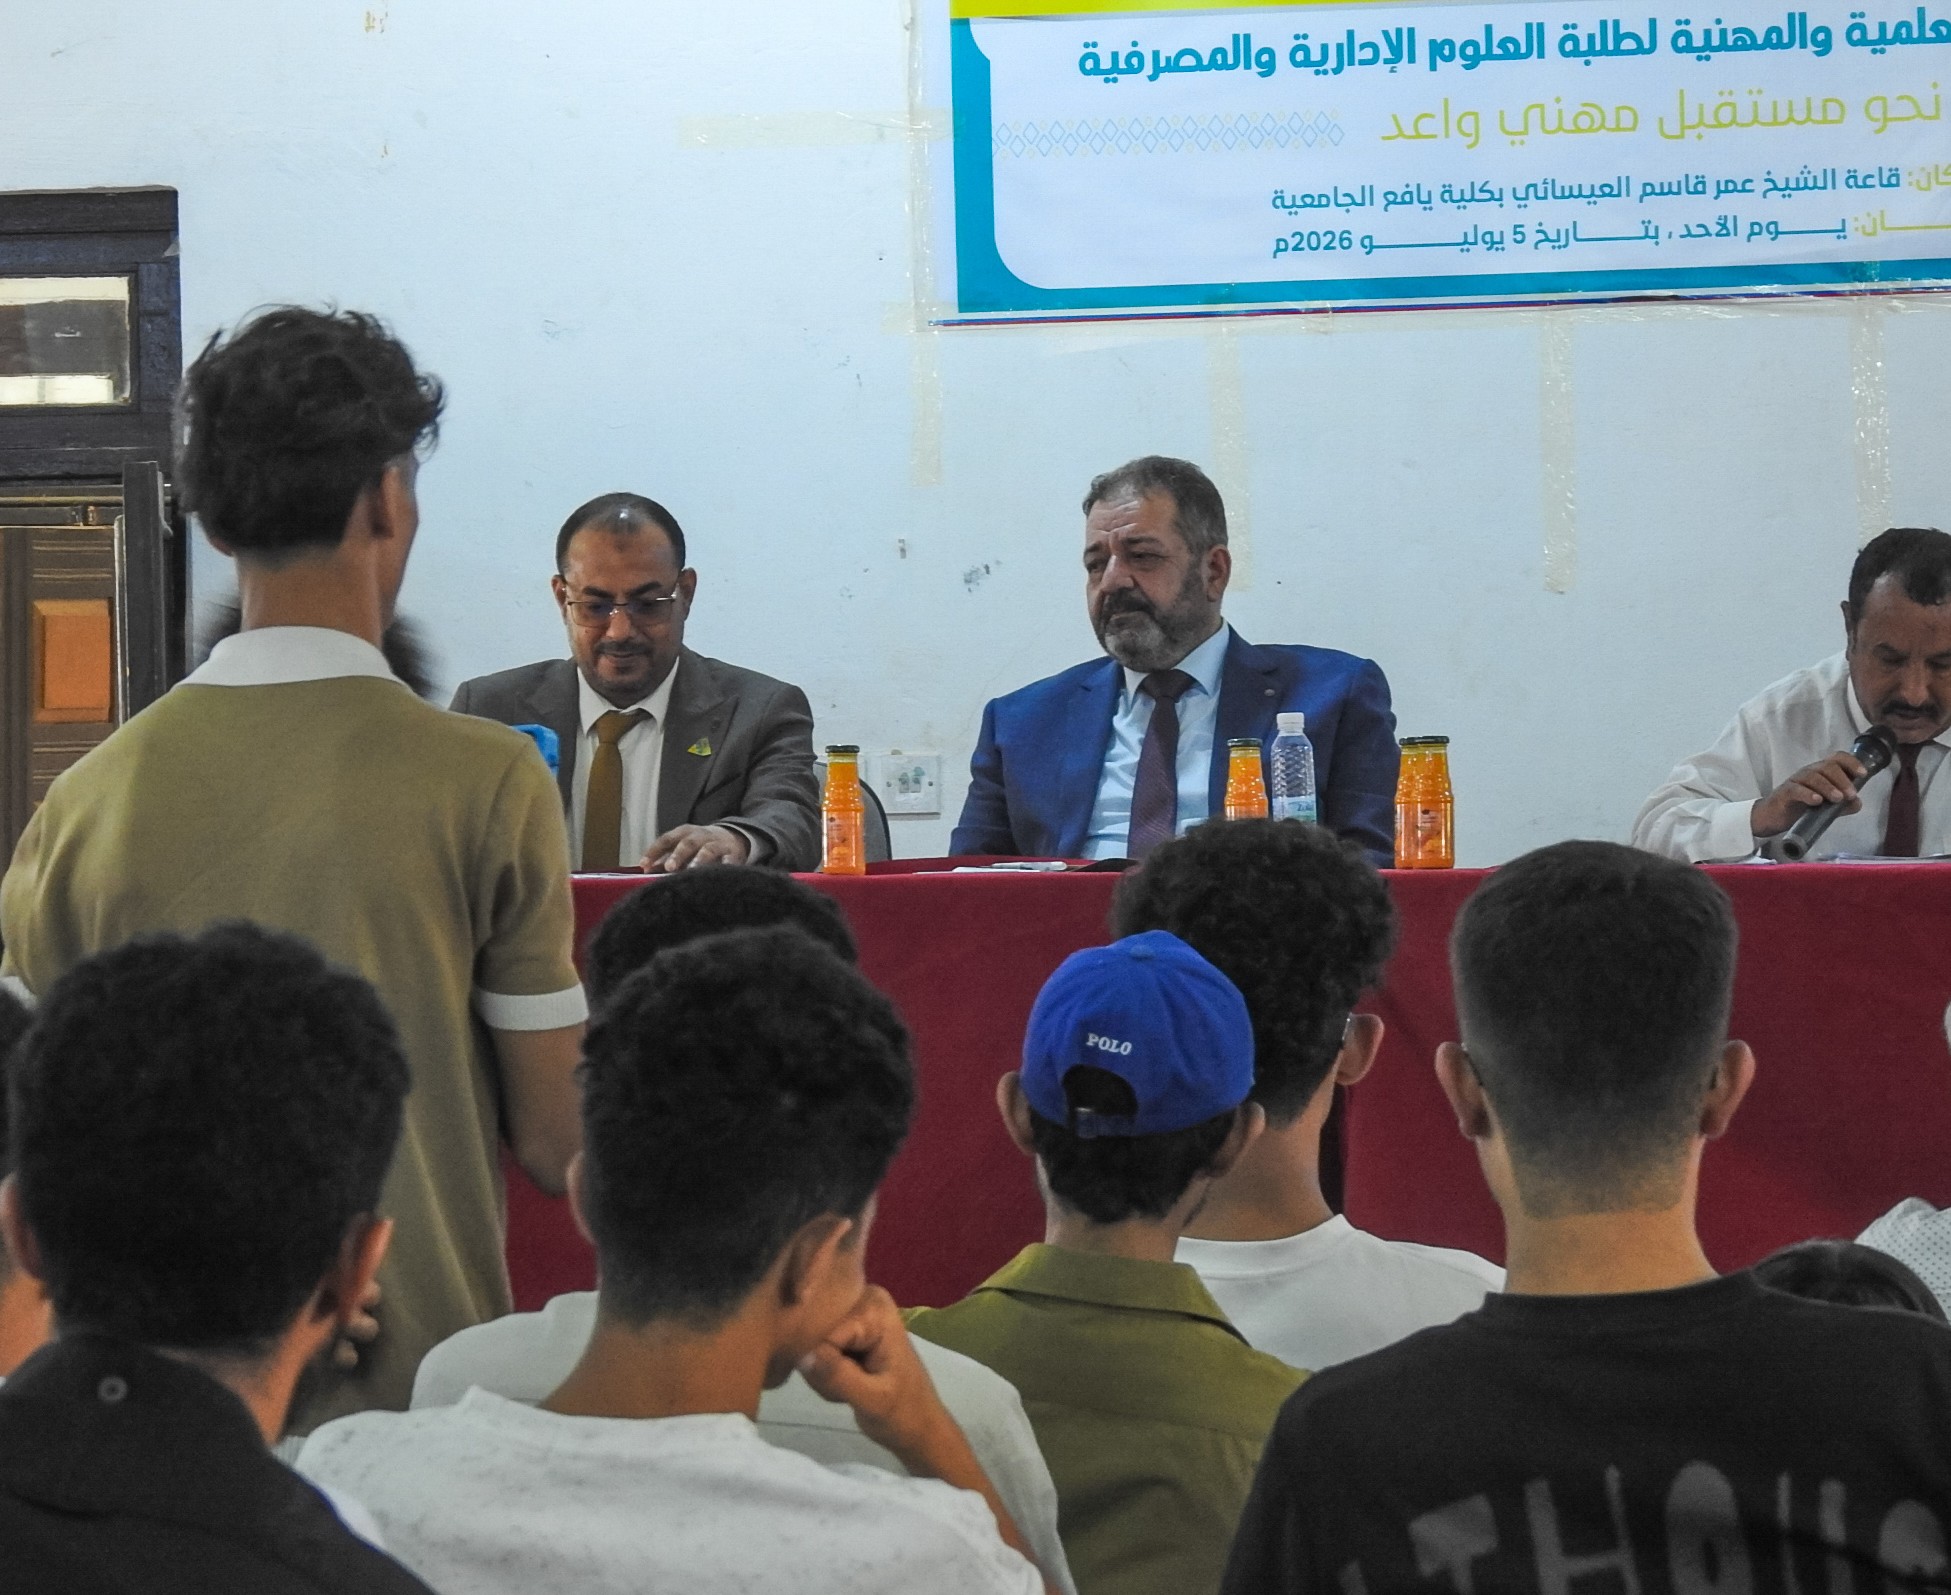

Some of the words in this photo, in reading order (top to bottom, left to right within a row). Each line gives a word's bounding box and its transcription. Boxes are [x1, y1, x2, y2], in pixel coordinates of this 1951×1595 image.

[1288, 26, 1417, 77] الإدارية
[1428, 21, 1546, 72] العلوم
[1557, 17, 1658, 67] لطلبة
[1669, 11, 1834, 63] والمهنية
[1077, 32, 1277, 85] والمصرفية
[1380, 97, 1481, 150] واعد
[1498, 96, 1640, 147] مهني
[1657, 88, 1847, 141] مستقبل
[1863, 81, 1941, 135] نحو
[1439, 180, 1505, 210] بكلية
[1511, 175, 1631, 209] العيسائي
[1638, 173, 1708, 204] قاسم
[1712, 177, 1756, 201] عمر
[1762, 164, 1837, 199] الشيخ
[1844, 166, 1901, 190] قاعة
[1271, 184, 1375, 217] الجامعية
[1382, 182, 1434, 213] يافع
[1272, 229, 1354, 260] 2026م
[1512, 223, 1527, 245] 5
[1085, 1032, 1133, 1056] POLO
